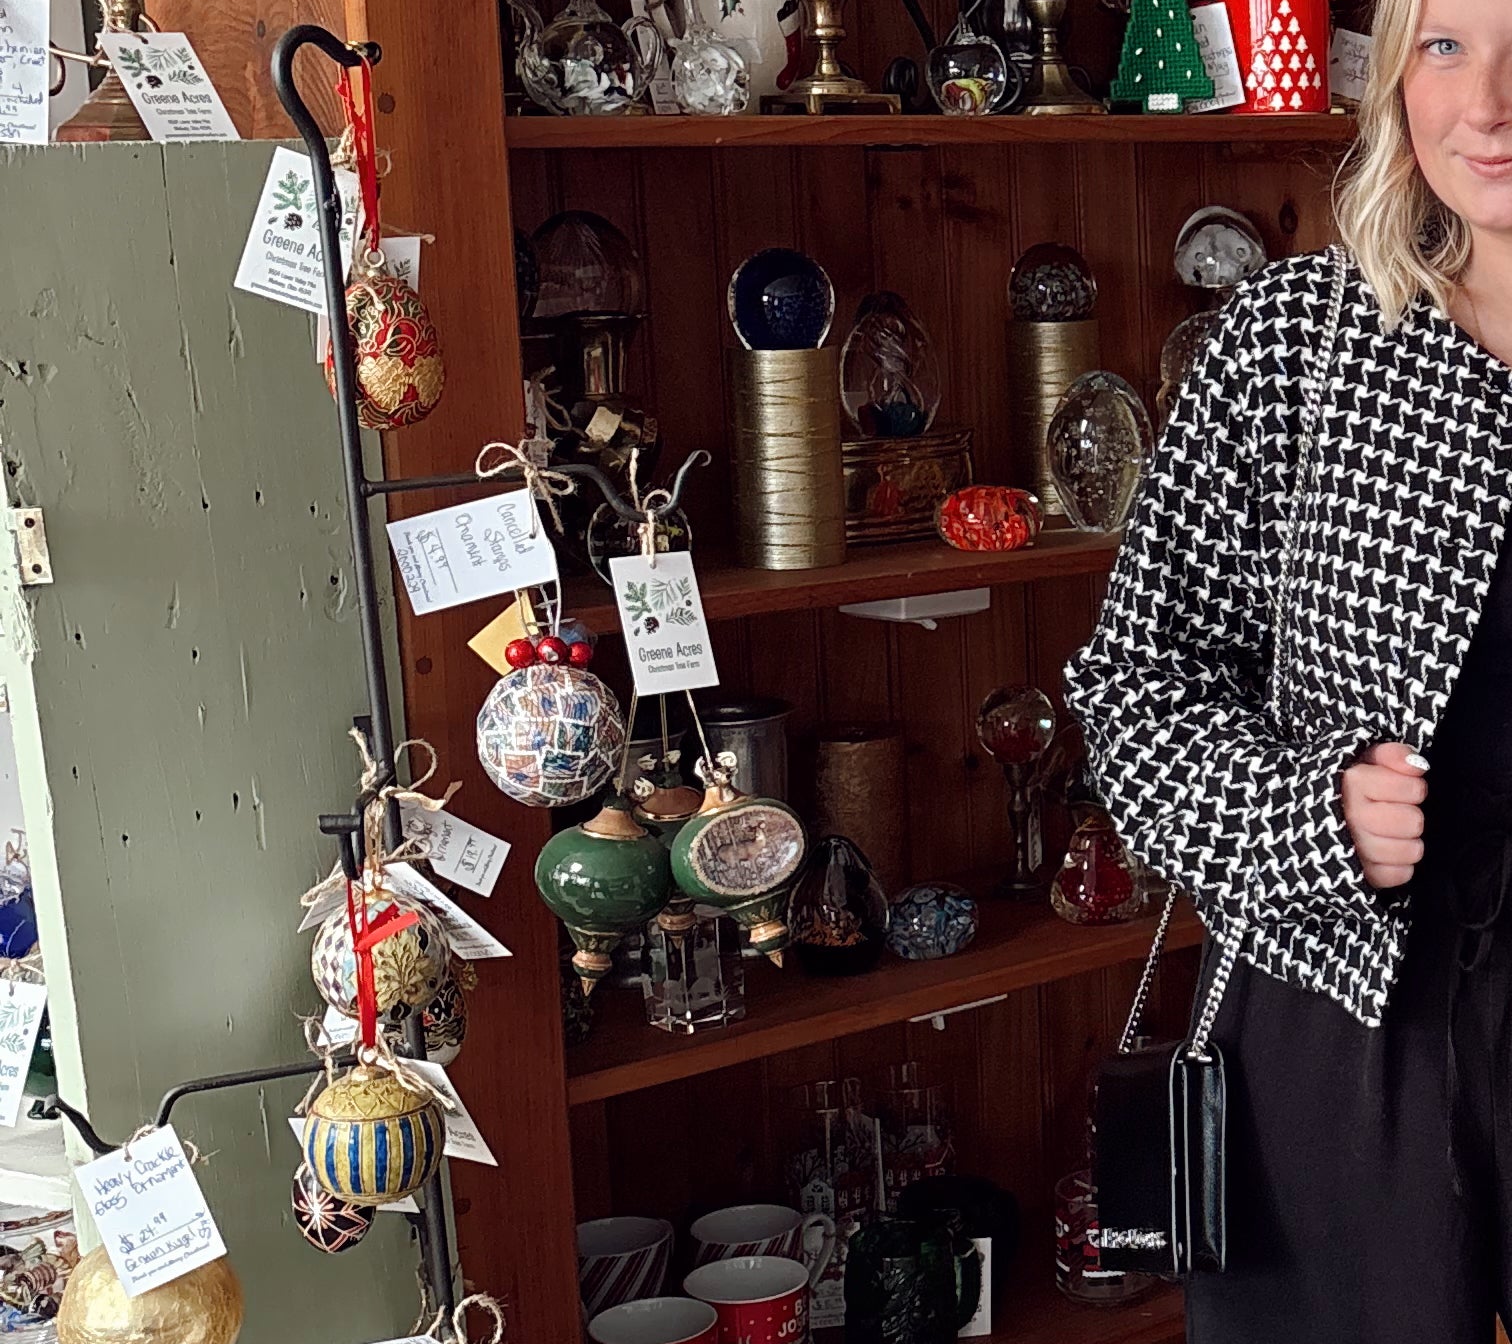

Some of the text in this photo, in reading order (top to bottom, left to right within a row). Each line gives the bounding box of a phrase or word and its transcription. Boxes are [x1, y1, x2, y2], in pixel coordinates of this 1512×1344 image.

[141, 90, 213, 104] Greene Acres
[263, 229, 305, 255] Greene
[638, 642, 703, 662] Greene Acres
